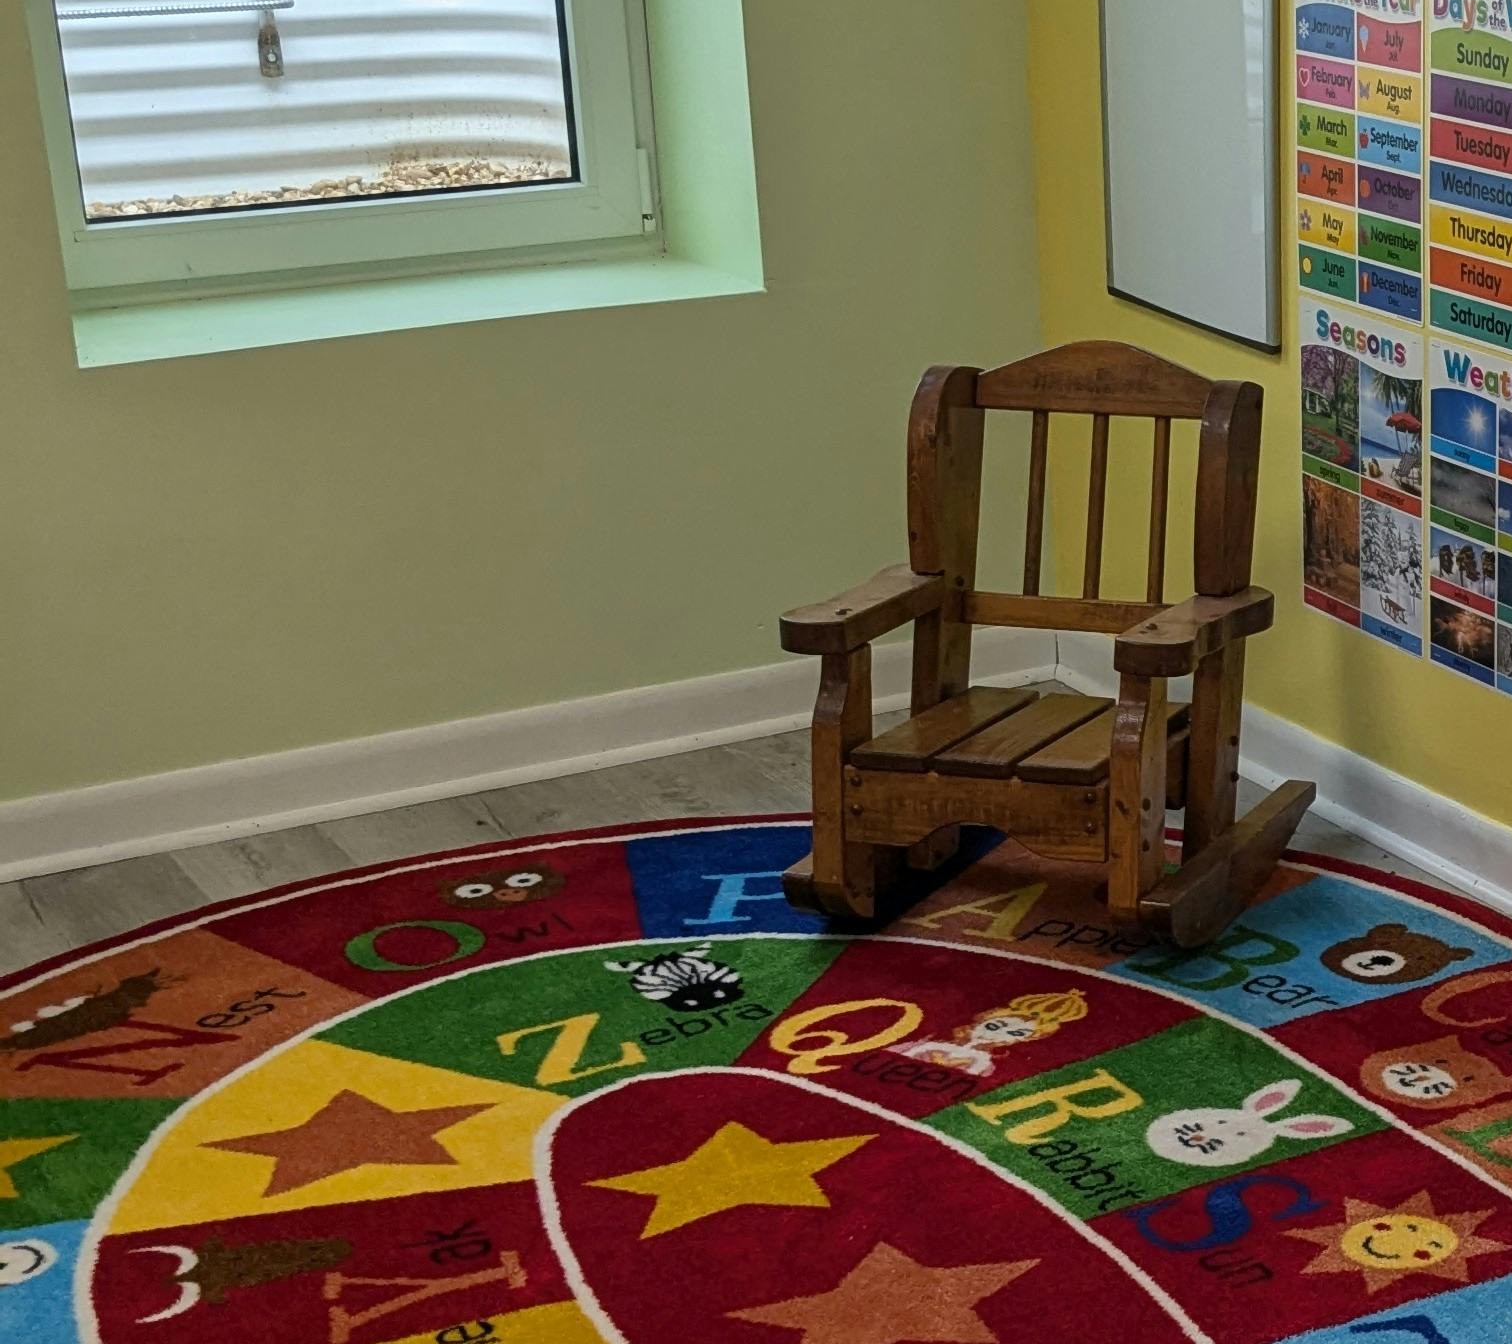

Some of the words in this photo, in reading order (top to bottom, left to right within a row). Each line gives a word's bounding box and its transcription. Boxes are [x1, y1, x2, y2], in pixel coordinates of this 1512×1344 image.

[1310, 19, 1352, 44] January
[1488, 11, 1508, 30] the
[1383, 29, 1404, 55] July
[1456, 42, 1510, 73] Sunday
[1310, 65, 1353, 92] February
[1375, 78, 1412, 102] August
[1453, 88, 1511, 121] Monday
[1316, 115, 1348, 137] March
[1370, 127, 1419, 155] September
[1454, 130, 1511, 167] Tuesday
[1320, 164, 1344, 186] April
[1373, 175, 1415, 201] October
[1322, 211, 1344, 236] May
[1369, 229, 1418, 254] November
[1321, 258, 1345, 278] June
[1460, 262, 1502, 296] Friday
[1370, 269, 1419, 300] December
[1450, 302, 1512, 342] Saturday
[1316, 308, 1408, 368] Seasons
[344, 912, 577, 972] Owl
[497, 999, 777, 1086] Zebra
[768, 996, 980, 1104] Queen
[966, 1069, 1148, 1214] Rabbit
[1121, 1172, 1330, 1289] Sun
